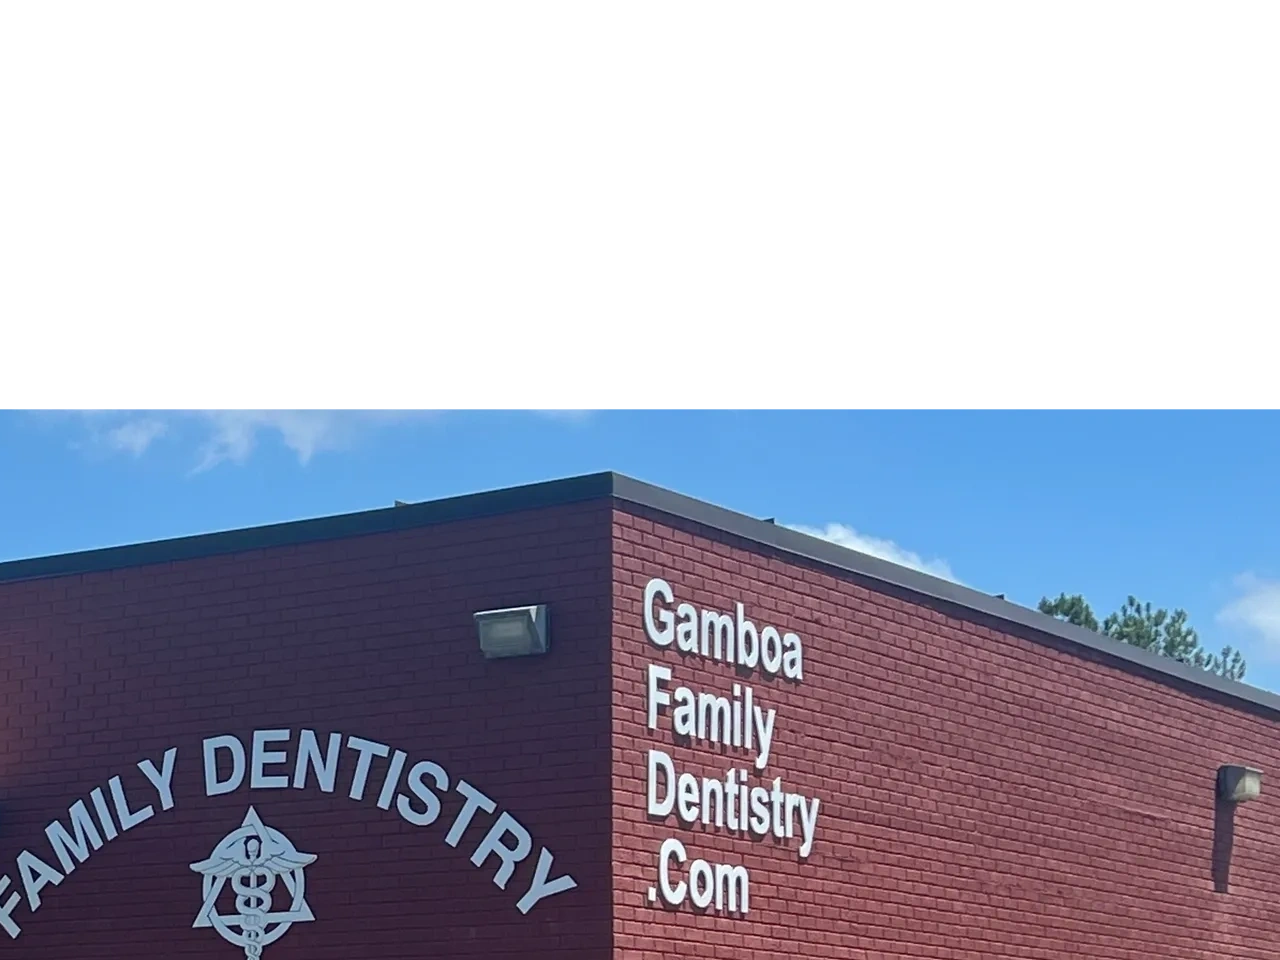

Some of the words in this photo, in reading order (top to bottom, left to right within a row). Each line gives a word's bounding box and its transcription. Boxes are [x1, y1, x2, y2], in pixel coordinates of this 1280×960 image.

[643, 578, 803, 681] Gamboa
[647, 664, 776, 769] Family
[203, 728, 578, 915] DENTISTRY
[647, 750, 819, 858] Dentistry
[647, 838, 749, 913] .Com
